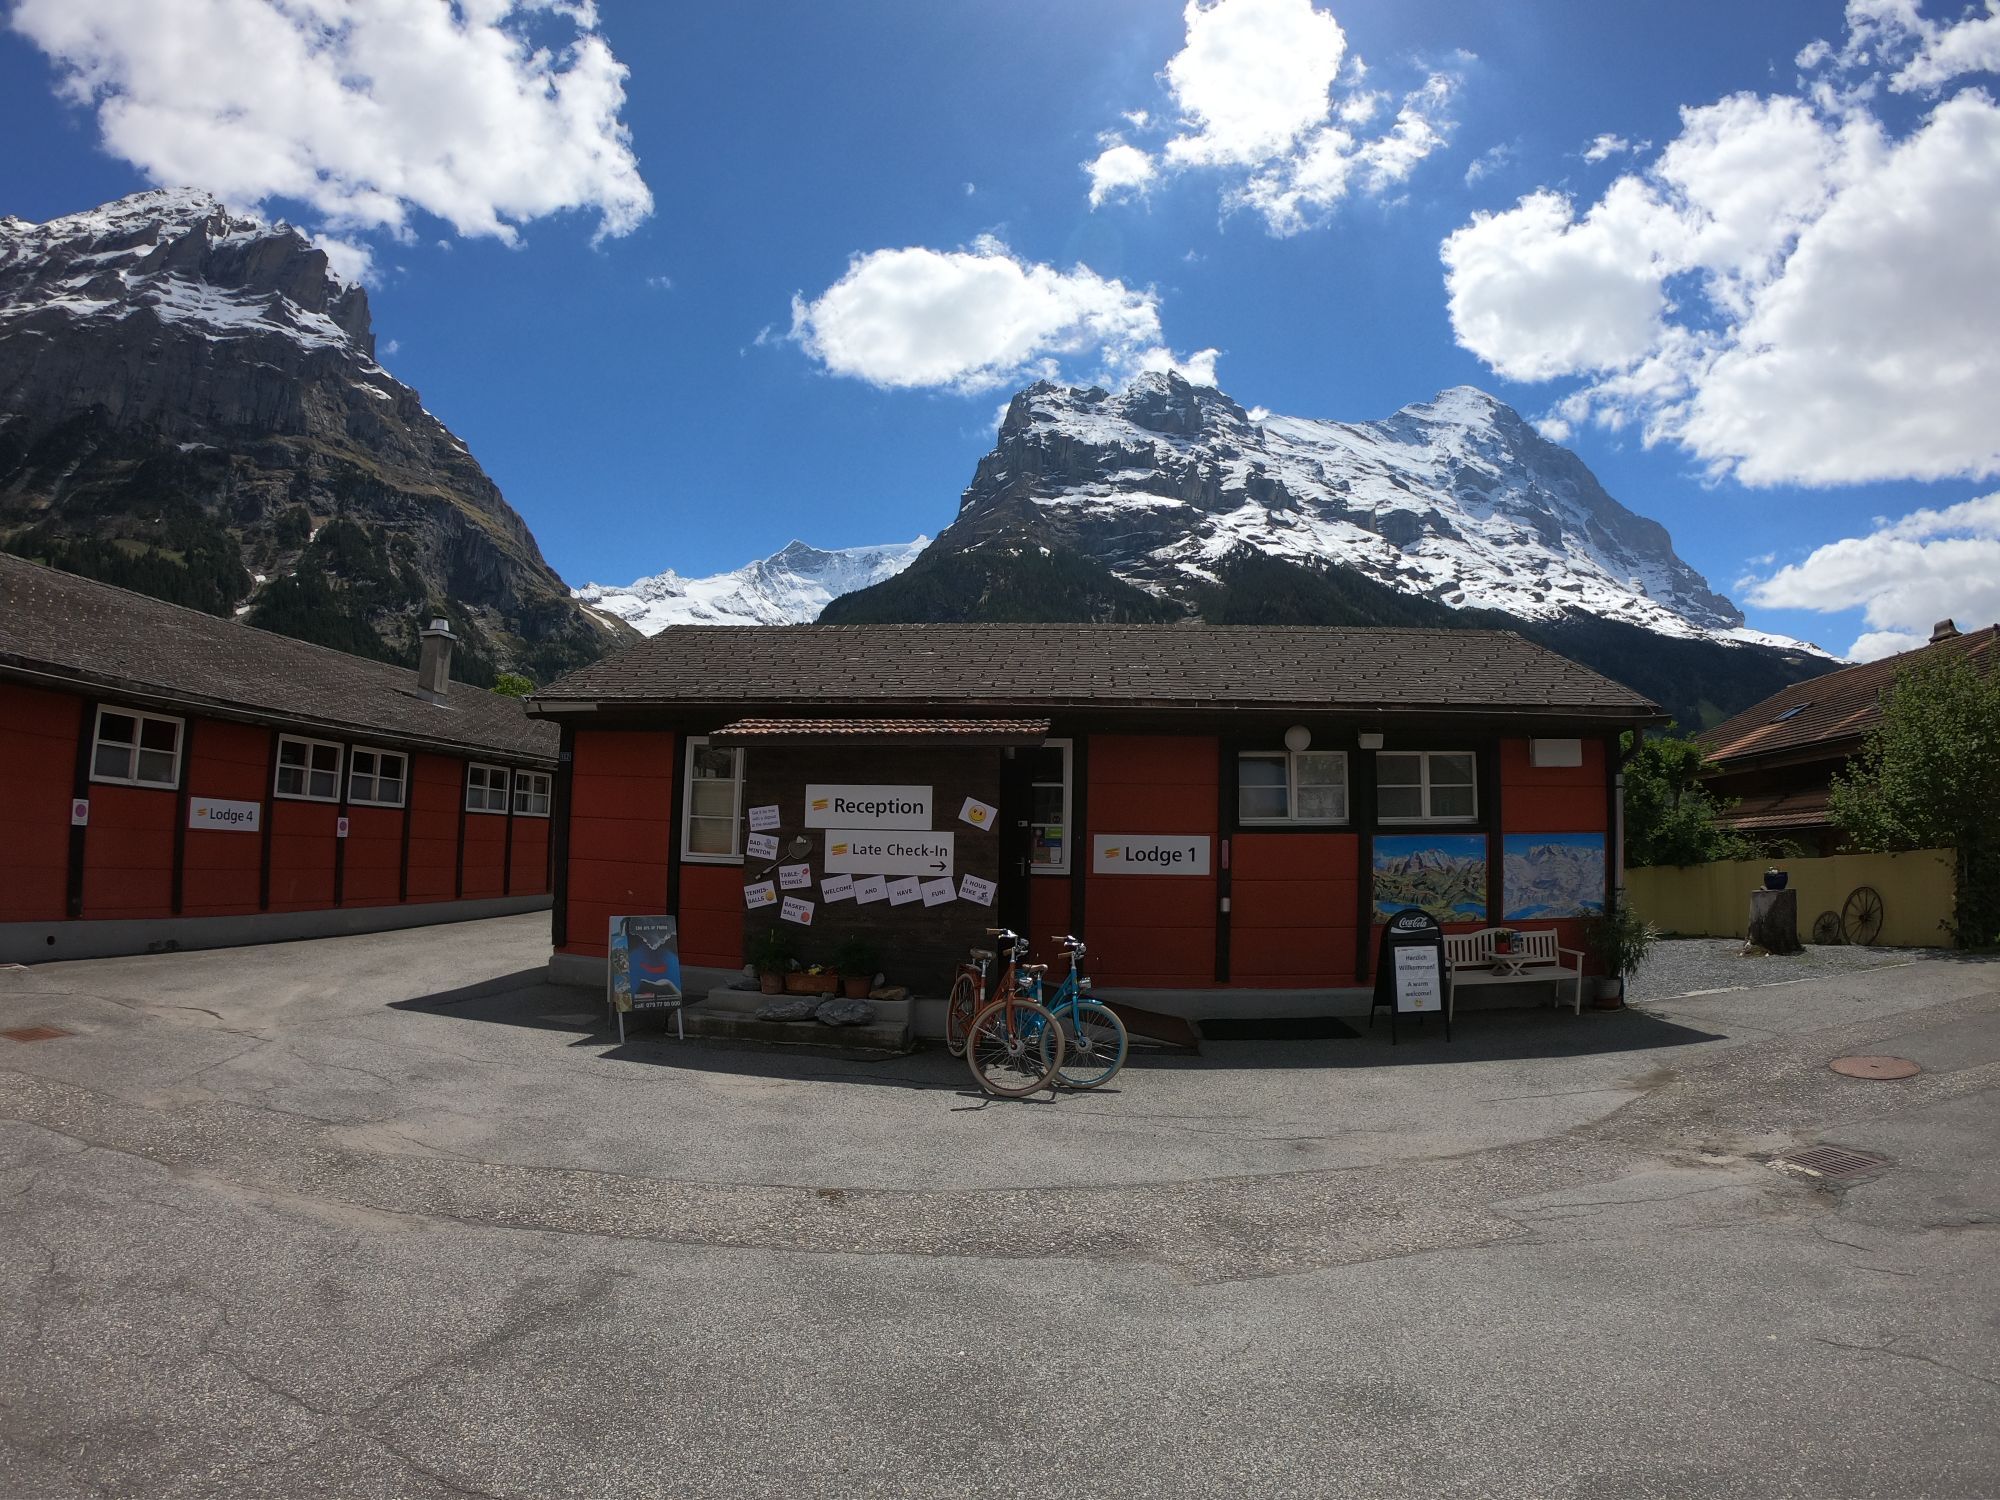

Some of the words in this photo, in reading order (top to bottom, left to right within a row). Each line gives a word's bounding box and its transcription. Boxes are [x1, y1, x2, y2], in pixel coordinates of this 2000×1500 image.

[834, 798, 924, 817] Reception
[209, 807, 244, 824] Lodge
[246, 810, 253, 822] 4
[748, 847, 771, 857] MINTON
[852, 844, 882, 856] Late
[887, 843, 948, 857] Check-In
[1126, 846, 1182, 866] Lodge
[1188, 847, 1195, 862] 1
[969, 880, 987, 890] HOUR
[823, 884, 853, 896] WELCOME
[864, 887, 878, 895] AND
[896, 888, 913, 897] HAVE
[931, 889, 946, 898] FUN!
[961, 886, 977, 896] BIKE
[748, 896, 765, 904] BALLS
[783, 909, 796, 917] BALL
[1399, 963, 1436, 971] Willkommen!
